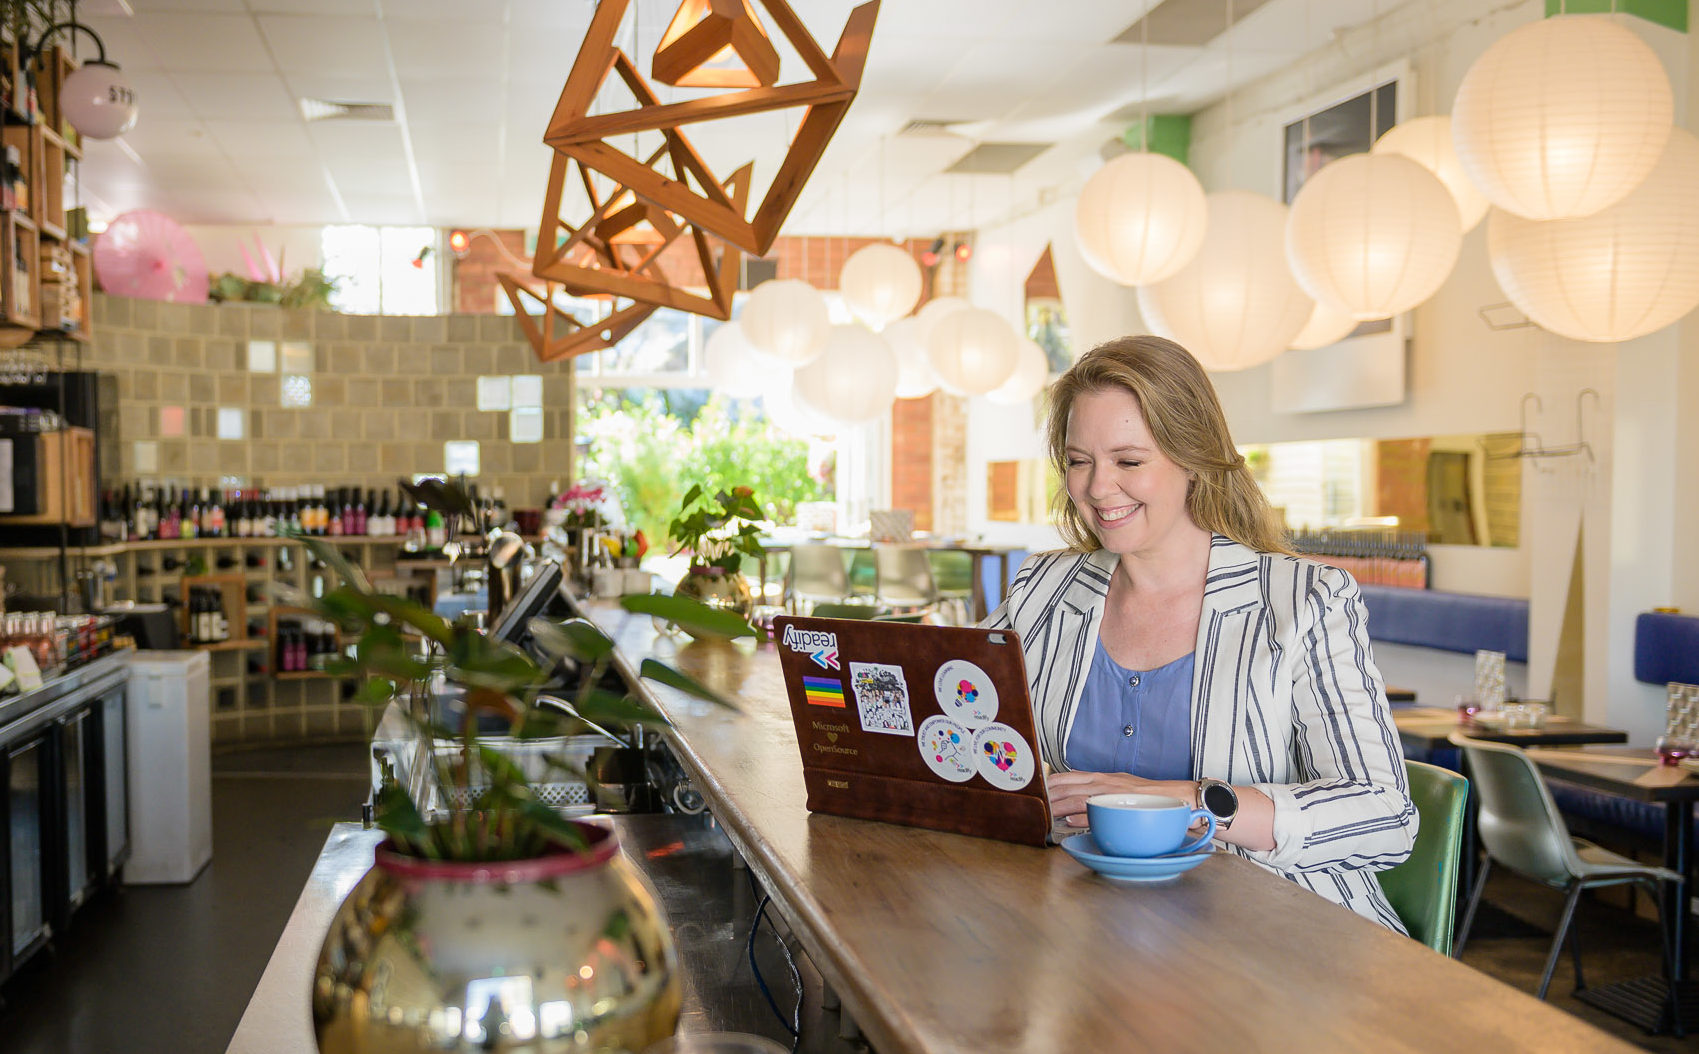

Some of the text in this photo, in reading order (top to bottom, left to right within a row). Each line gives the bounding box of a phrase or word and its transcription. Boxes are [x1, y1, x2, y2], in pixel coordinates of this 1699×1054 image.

[784, 625, 836, 650] readify
[812, 721, 850, 733] Microsoft
[813, 743, 858, 756] OpenSource
